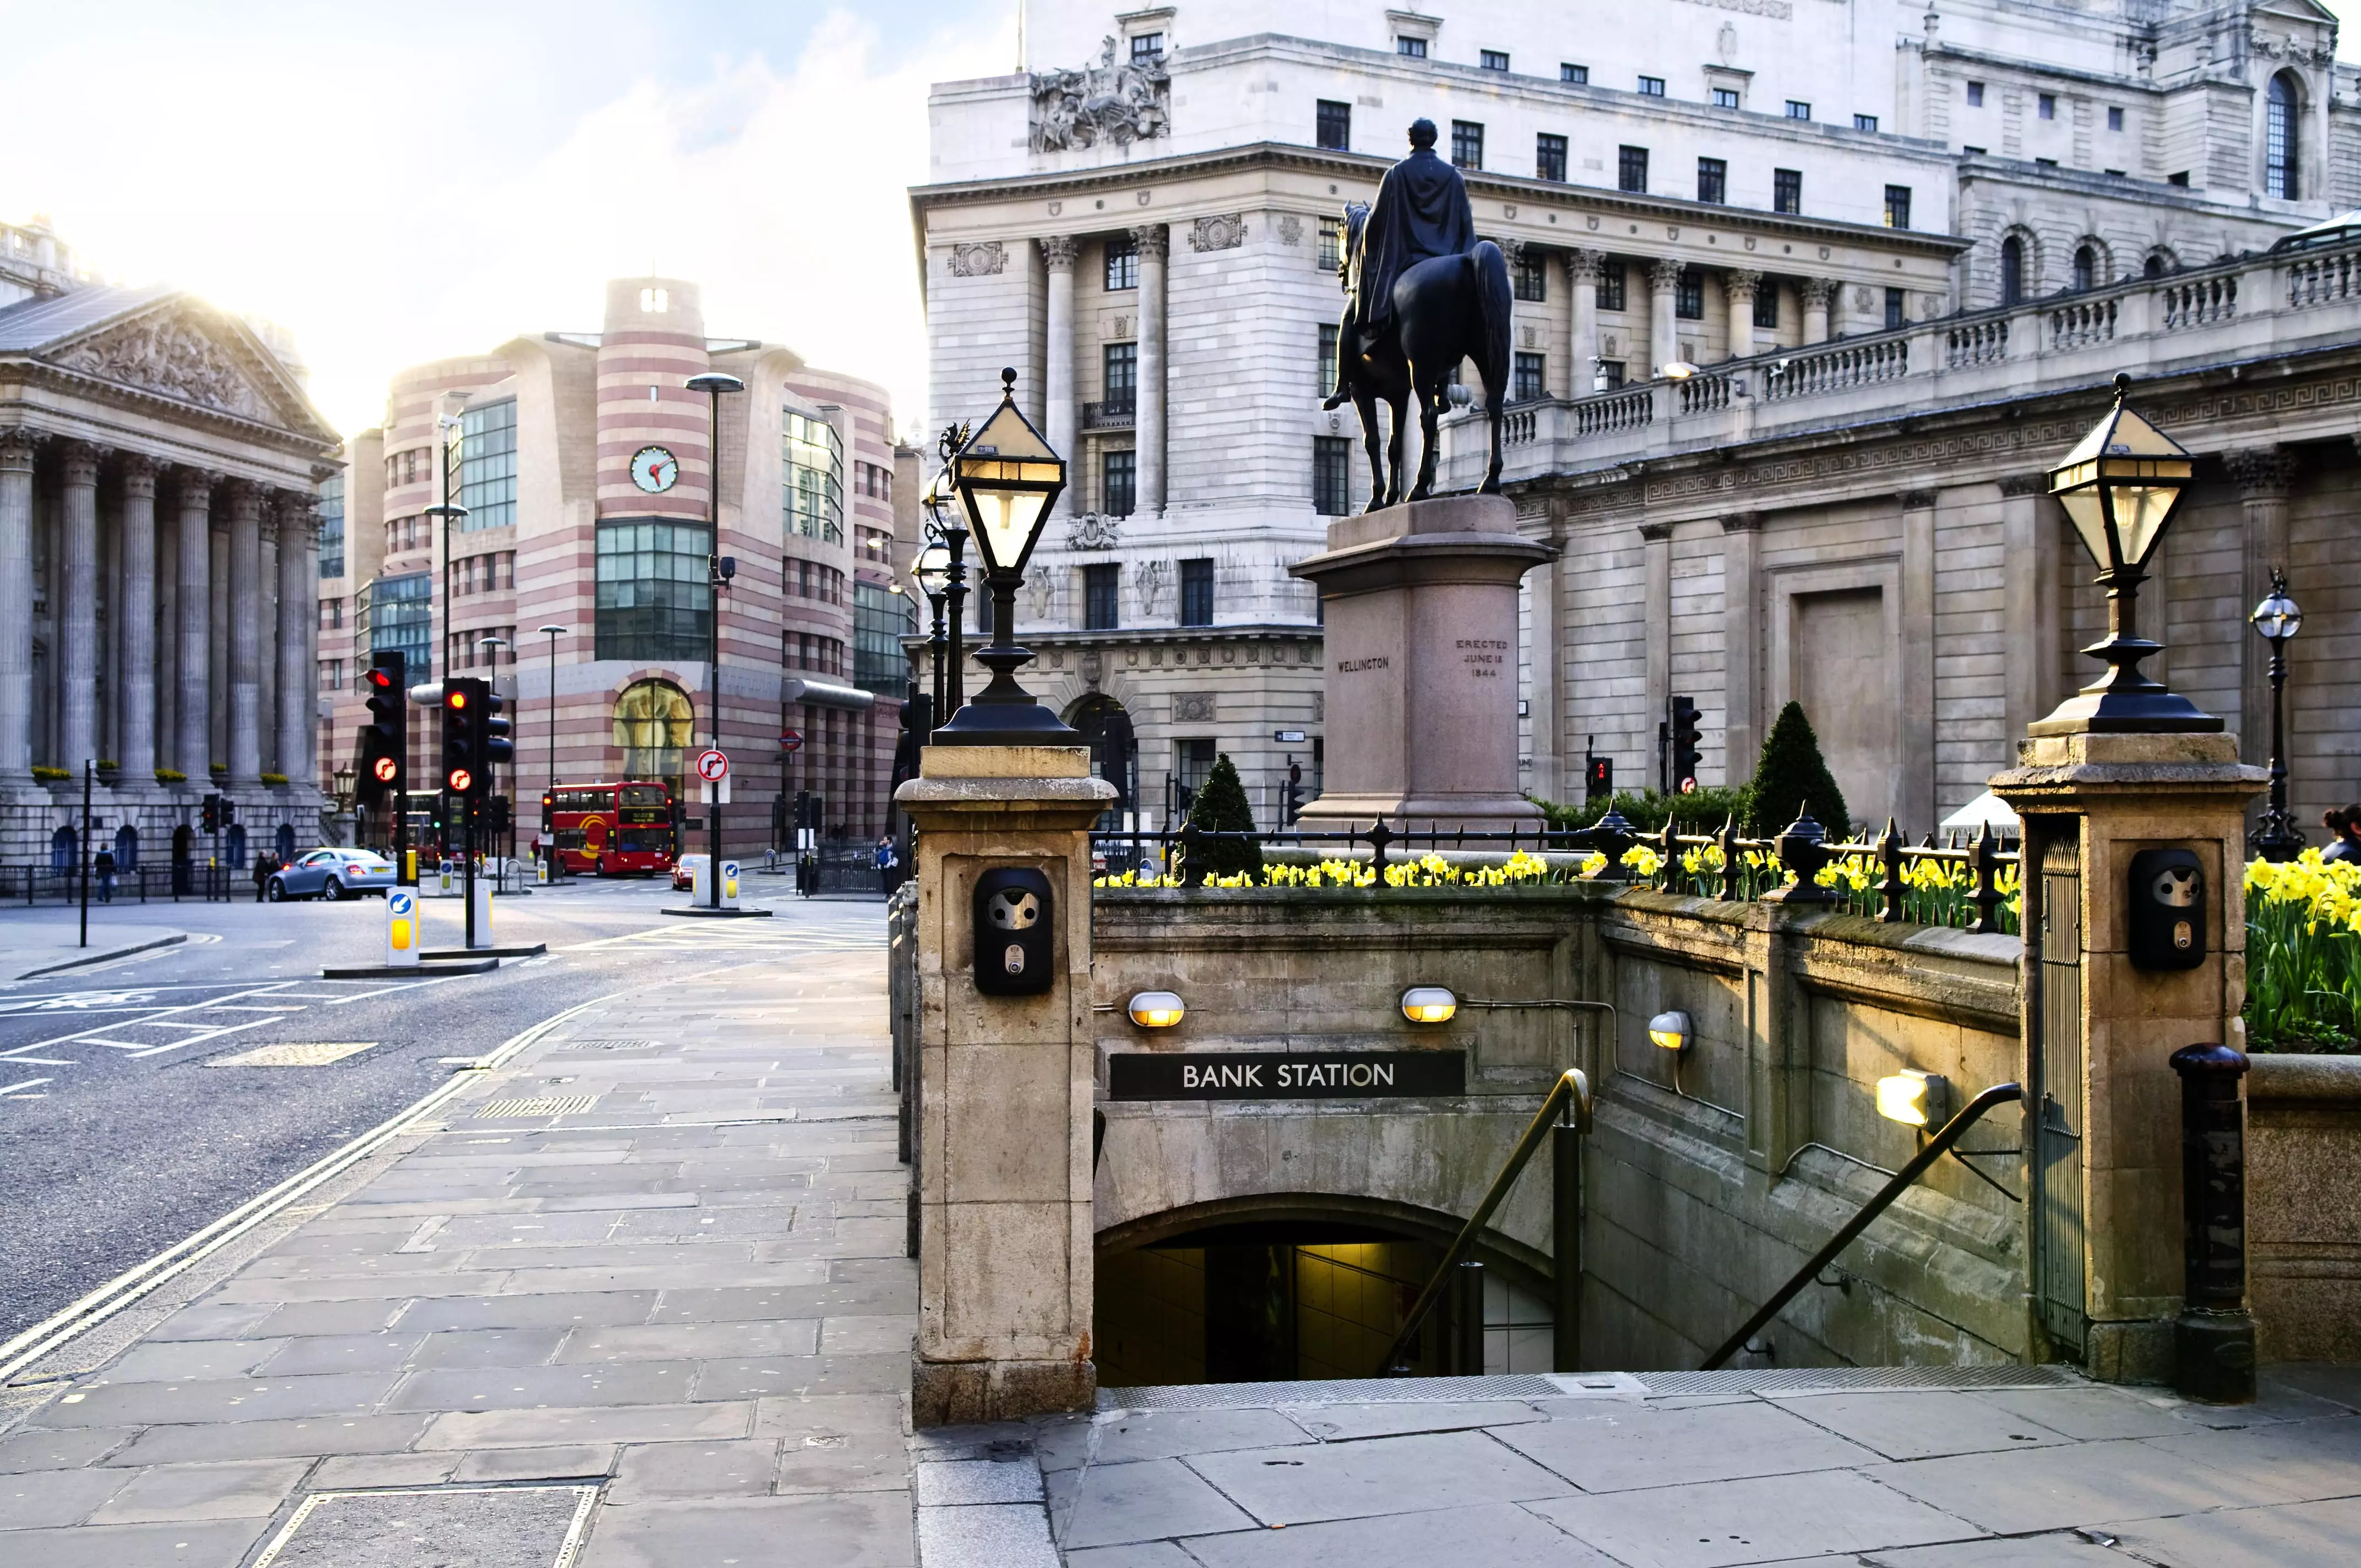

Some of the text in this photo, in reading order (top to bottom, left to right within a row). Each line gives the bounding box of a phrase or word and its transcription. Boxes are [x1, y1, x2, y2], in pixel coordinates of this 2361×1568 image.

[1456, 640, 1508, 649] ERECTED
[1464, 655, 1503, 663] JUNE 18
[1338, 656, 1389, 674] WELLINGTON
[1472, 669, 1497, 677] 1844
[1946, 827, 1973, 836] ROYAL
[1183, 1064, 1394, 1087] BANK STATION
